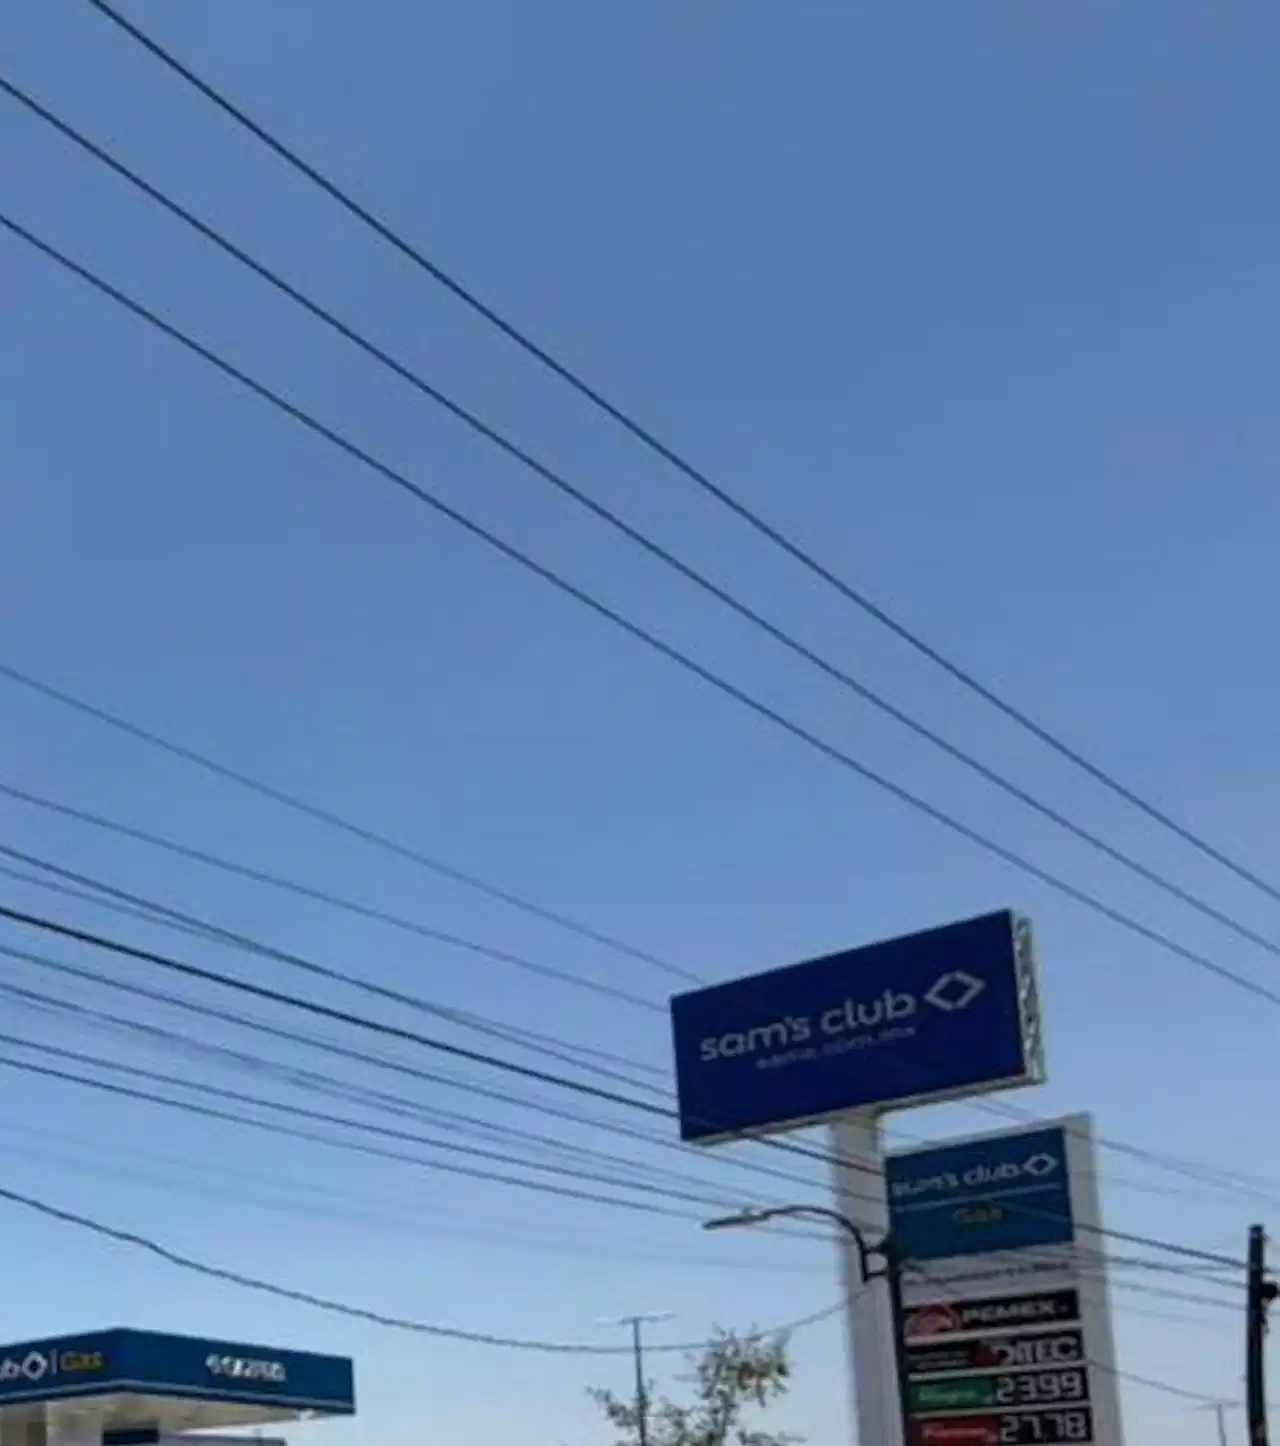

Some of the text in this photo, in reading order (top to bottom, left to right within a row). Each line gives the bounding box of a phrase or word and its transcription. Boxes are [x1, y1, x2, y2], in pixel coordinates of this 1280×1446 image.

[699, 1015, 812, 1062] sam's
[819, 988, 917, 1035] club
[962, 1161, 1021, 1187] club
[962, 1300, 1055, 1323] PEMEX
